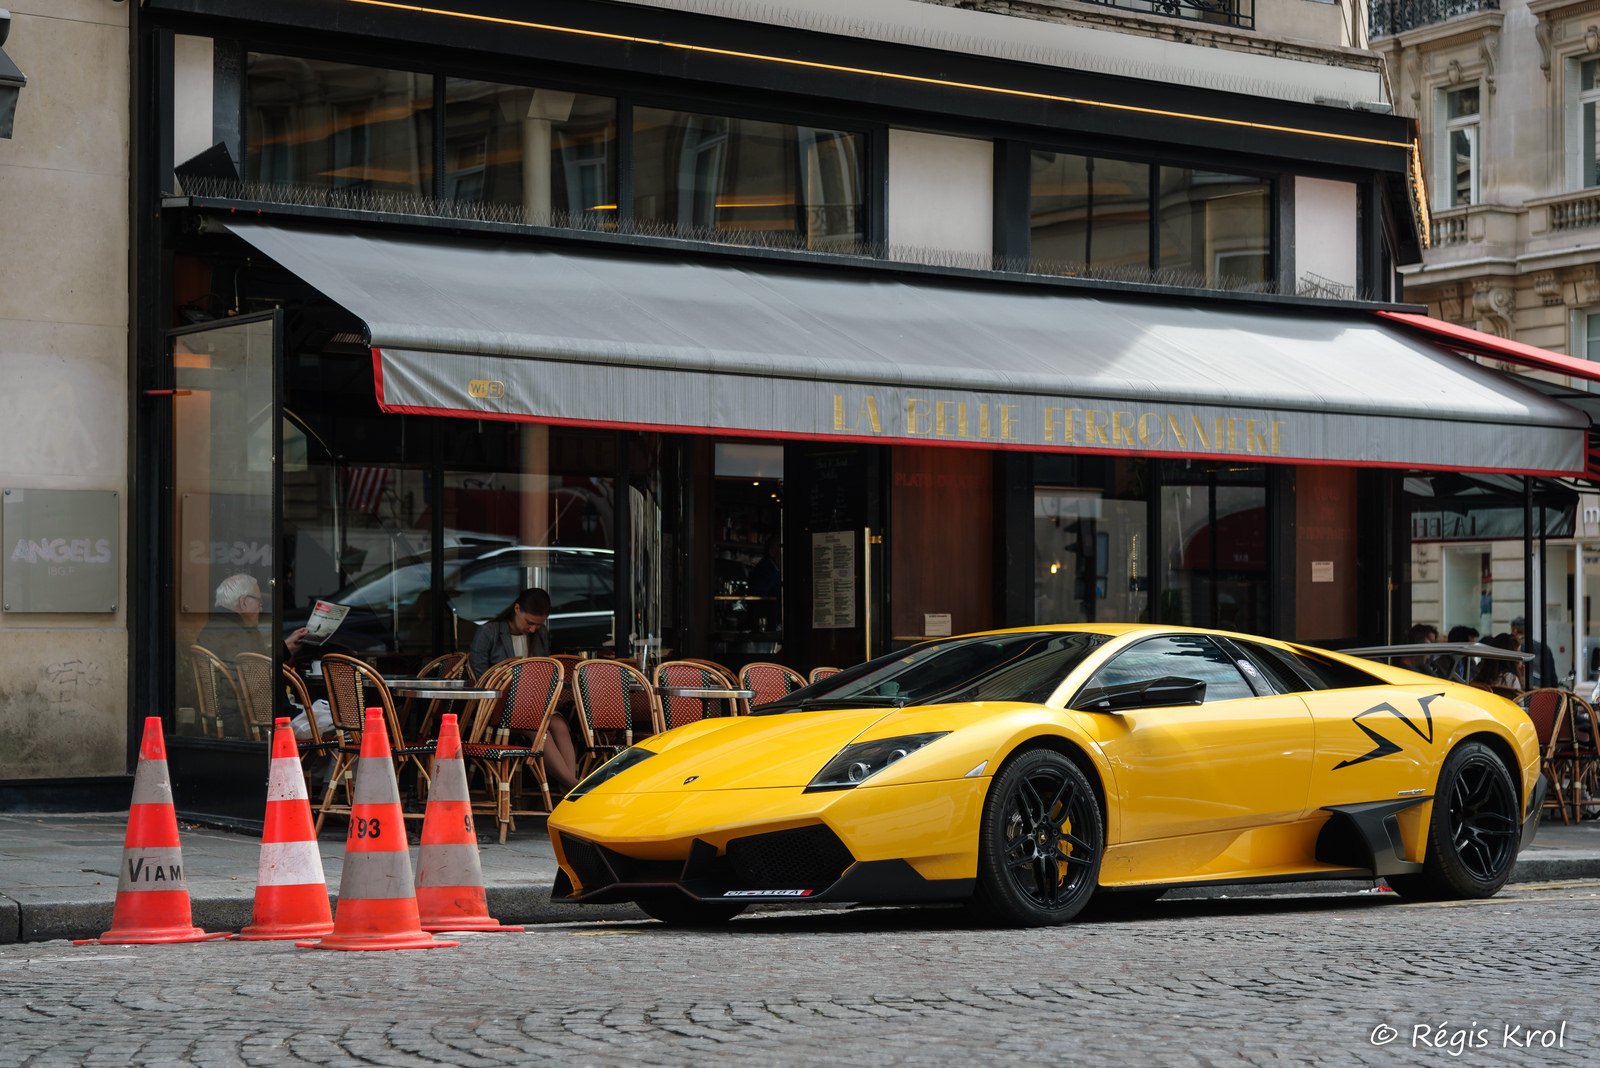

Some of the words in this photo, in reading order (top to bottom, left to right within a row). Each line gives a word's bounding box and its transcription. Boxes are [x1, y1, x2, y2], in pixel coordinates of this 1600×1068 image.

[833, 393, 882, 433] LA
[906, 398, 1021, 440] BELLE
[10, 537, 112, 564] ANGELS
[357, 817, 381, 839] 93
